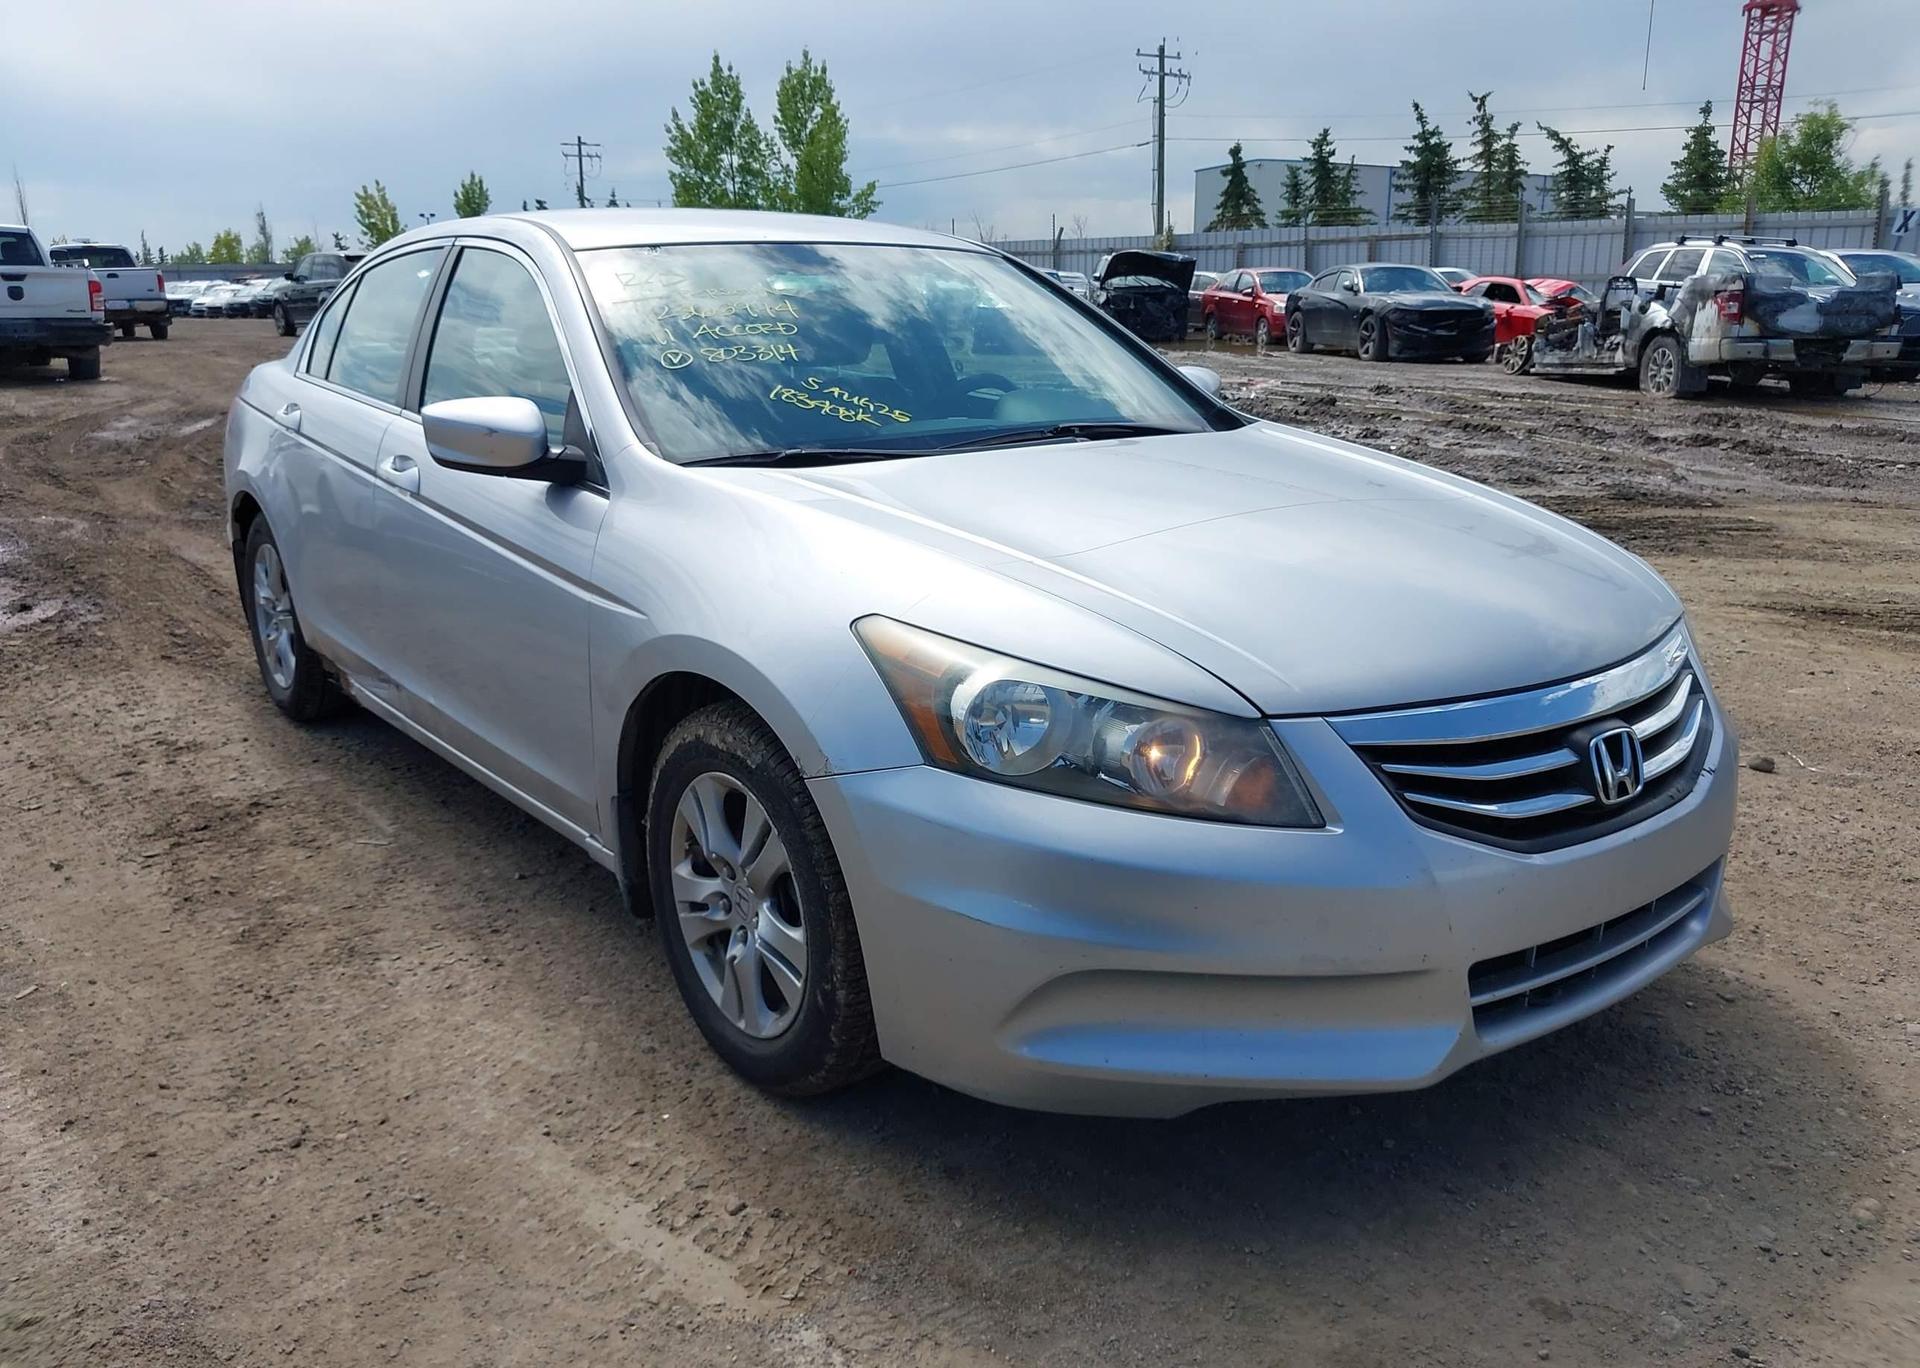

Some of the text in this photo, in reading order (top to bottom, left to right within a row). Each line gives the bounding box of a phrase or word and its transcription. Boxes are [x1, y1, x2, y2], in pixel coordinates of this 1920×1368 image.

[1895, 209, 1916, 233] X
[692, 321, 799, 339] ACCORD
[699, 343, 801, 362] 803314
